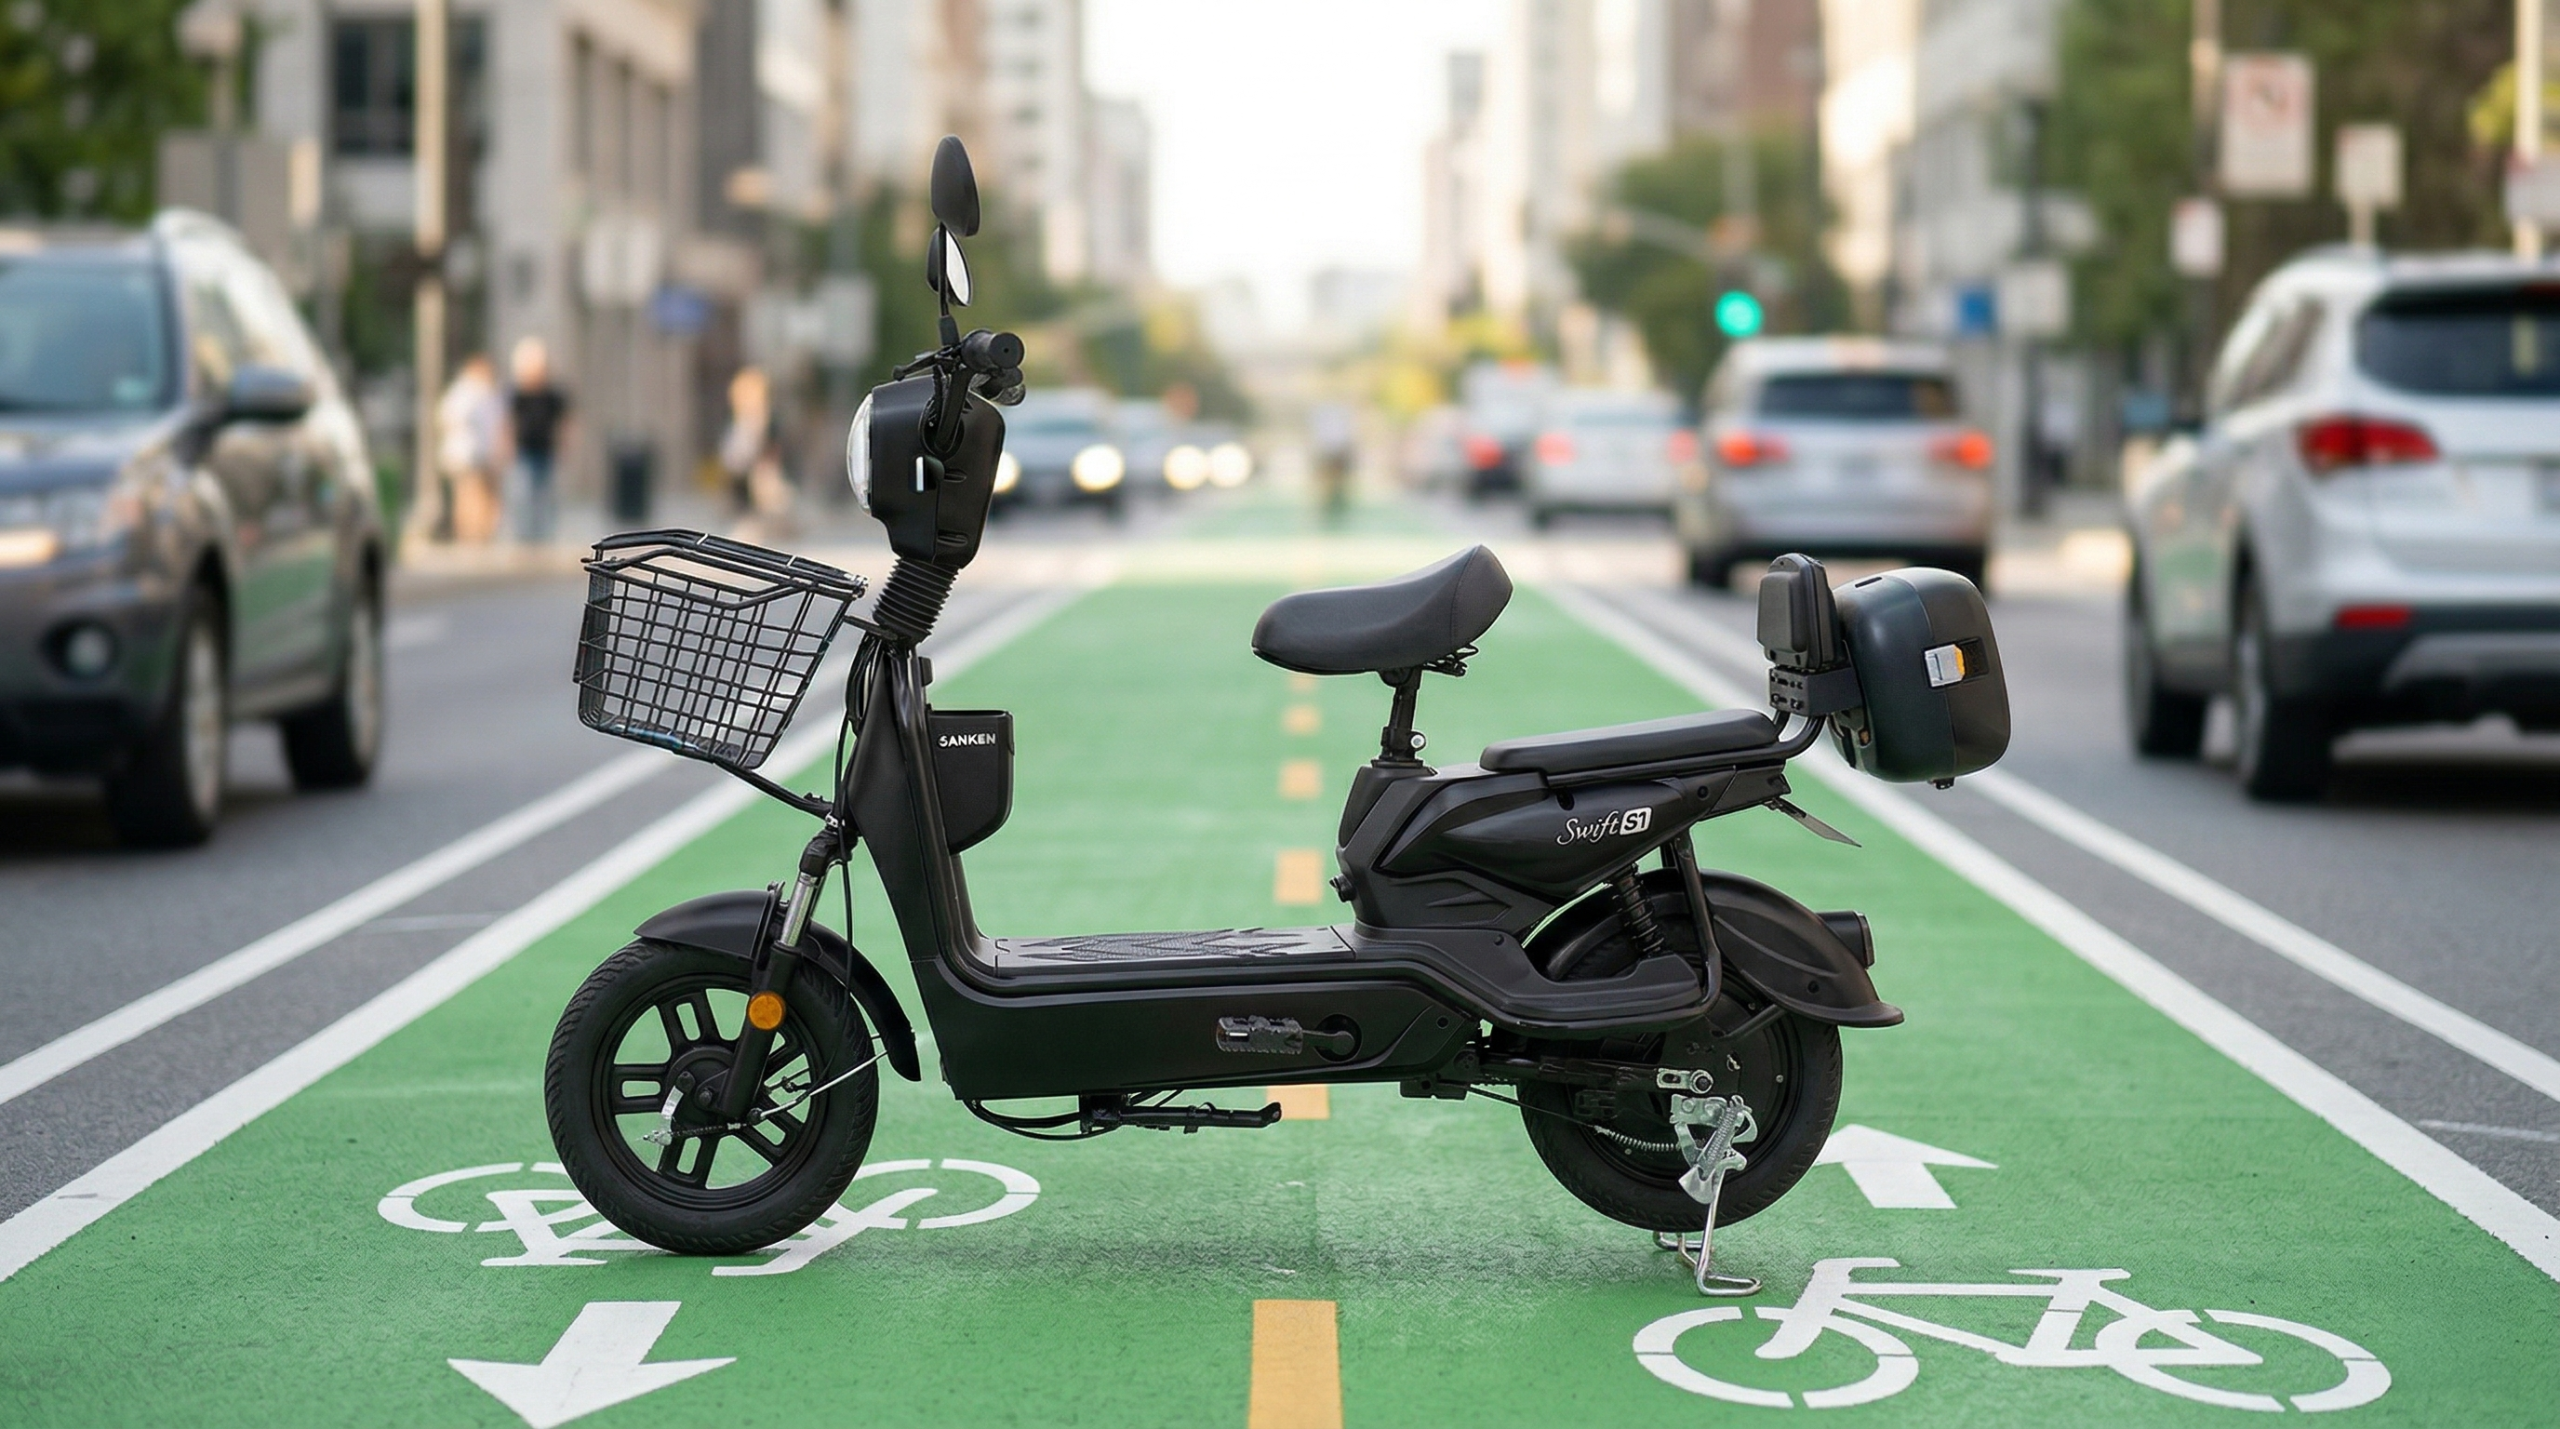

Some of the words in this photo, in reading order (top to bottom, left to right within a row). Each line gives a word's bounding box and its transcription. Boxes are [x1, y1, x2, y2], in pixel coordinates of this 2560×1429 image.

[939, 733, 996, 747] SANKEN
[1557, 810, 1619, 845] Swift
[1623, 810, 1648, 831] S1
